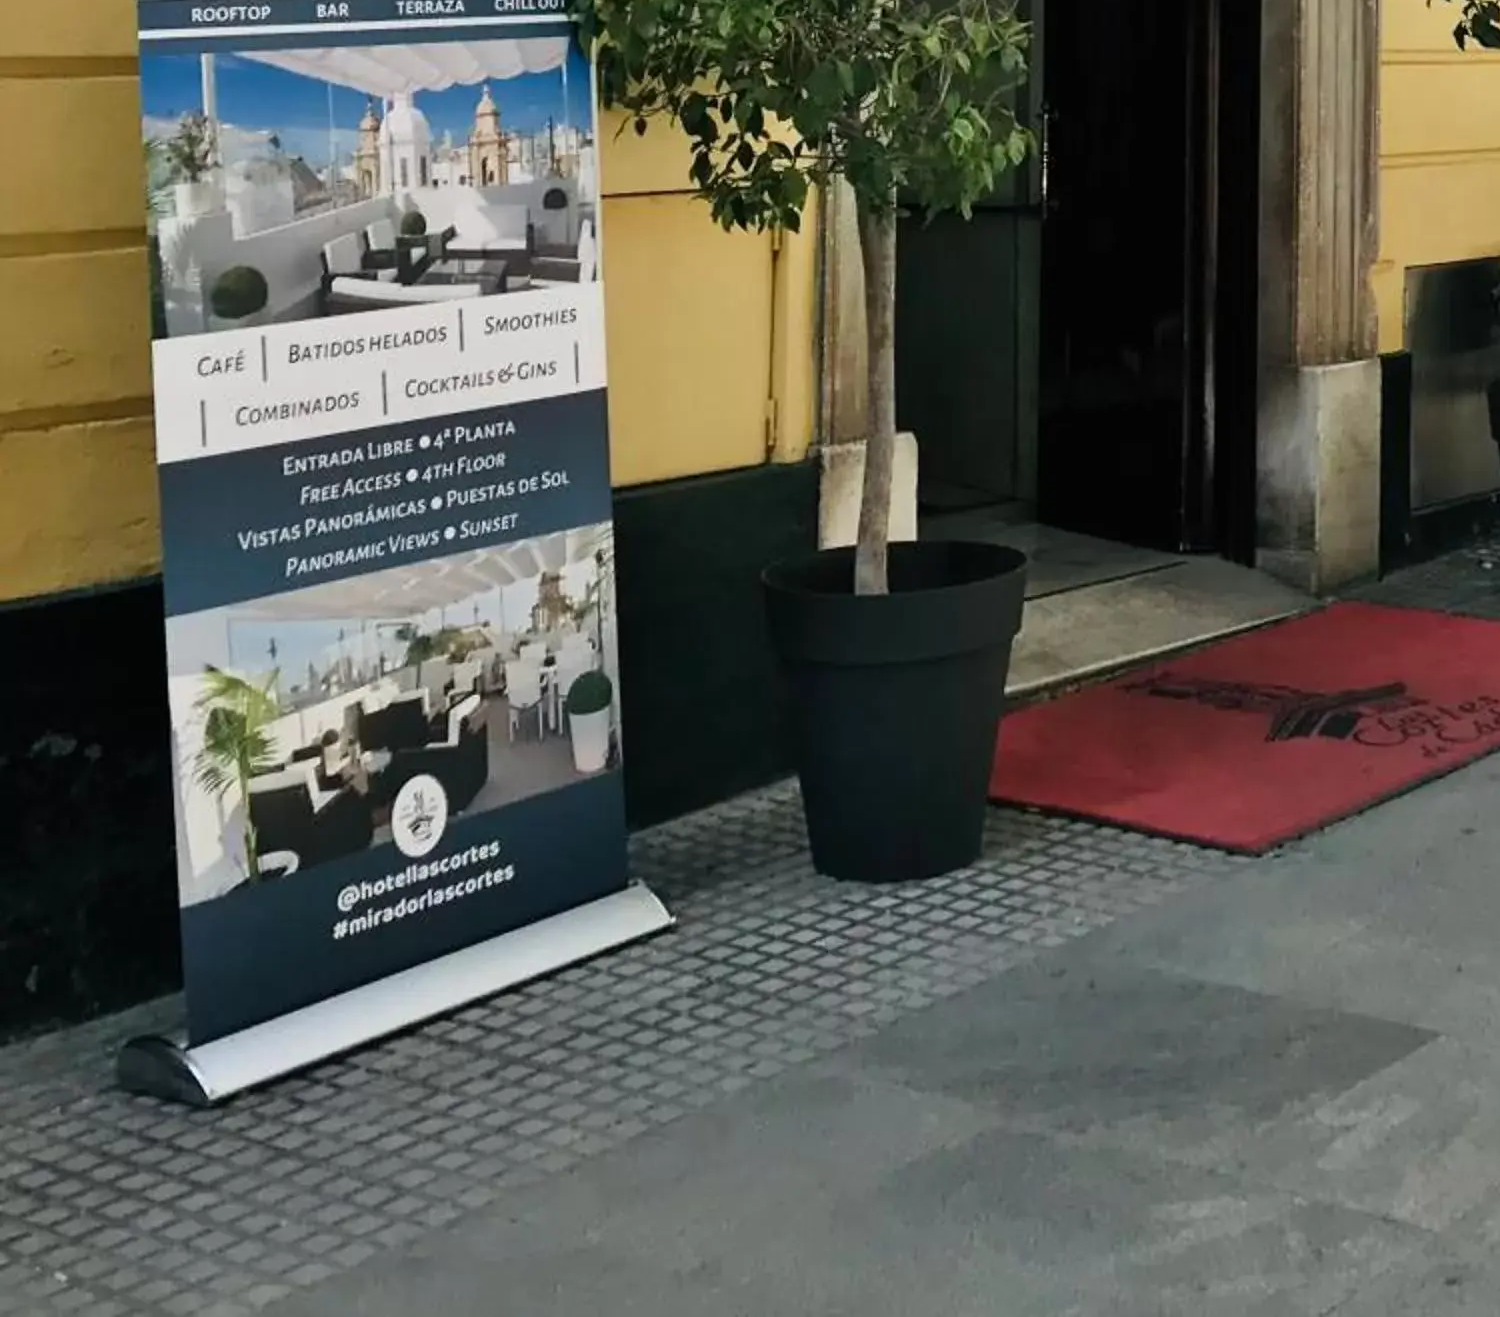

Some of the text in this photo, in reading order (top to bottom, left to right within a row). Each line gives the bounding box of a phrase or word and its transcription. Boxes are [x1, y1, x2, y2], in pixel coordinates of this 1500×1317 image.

[191, 6, 271, 23] ROOFTOP
[316, 2, 349, 18] BAR
[368, 325, 448, 352] HELADOS
[422, 462, 455, 483] 4TH
[518, 477, 539, 495] DE
[337, 840, 501, 912] @hotellascortes
[333, 864, 515, 940] #miradorlascortes
